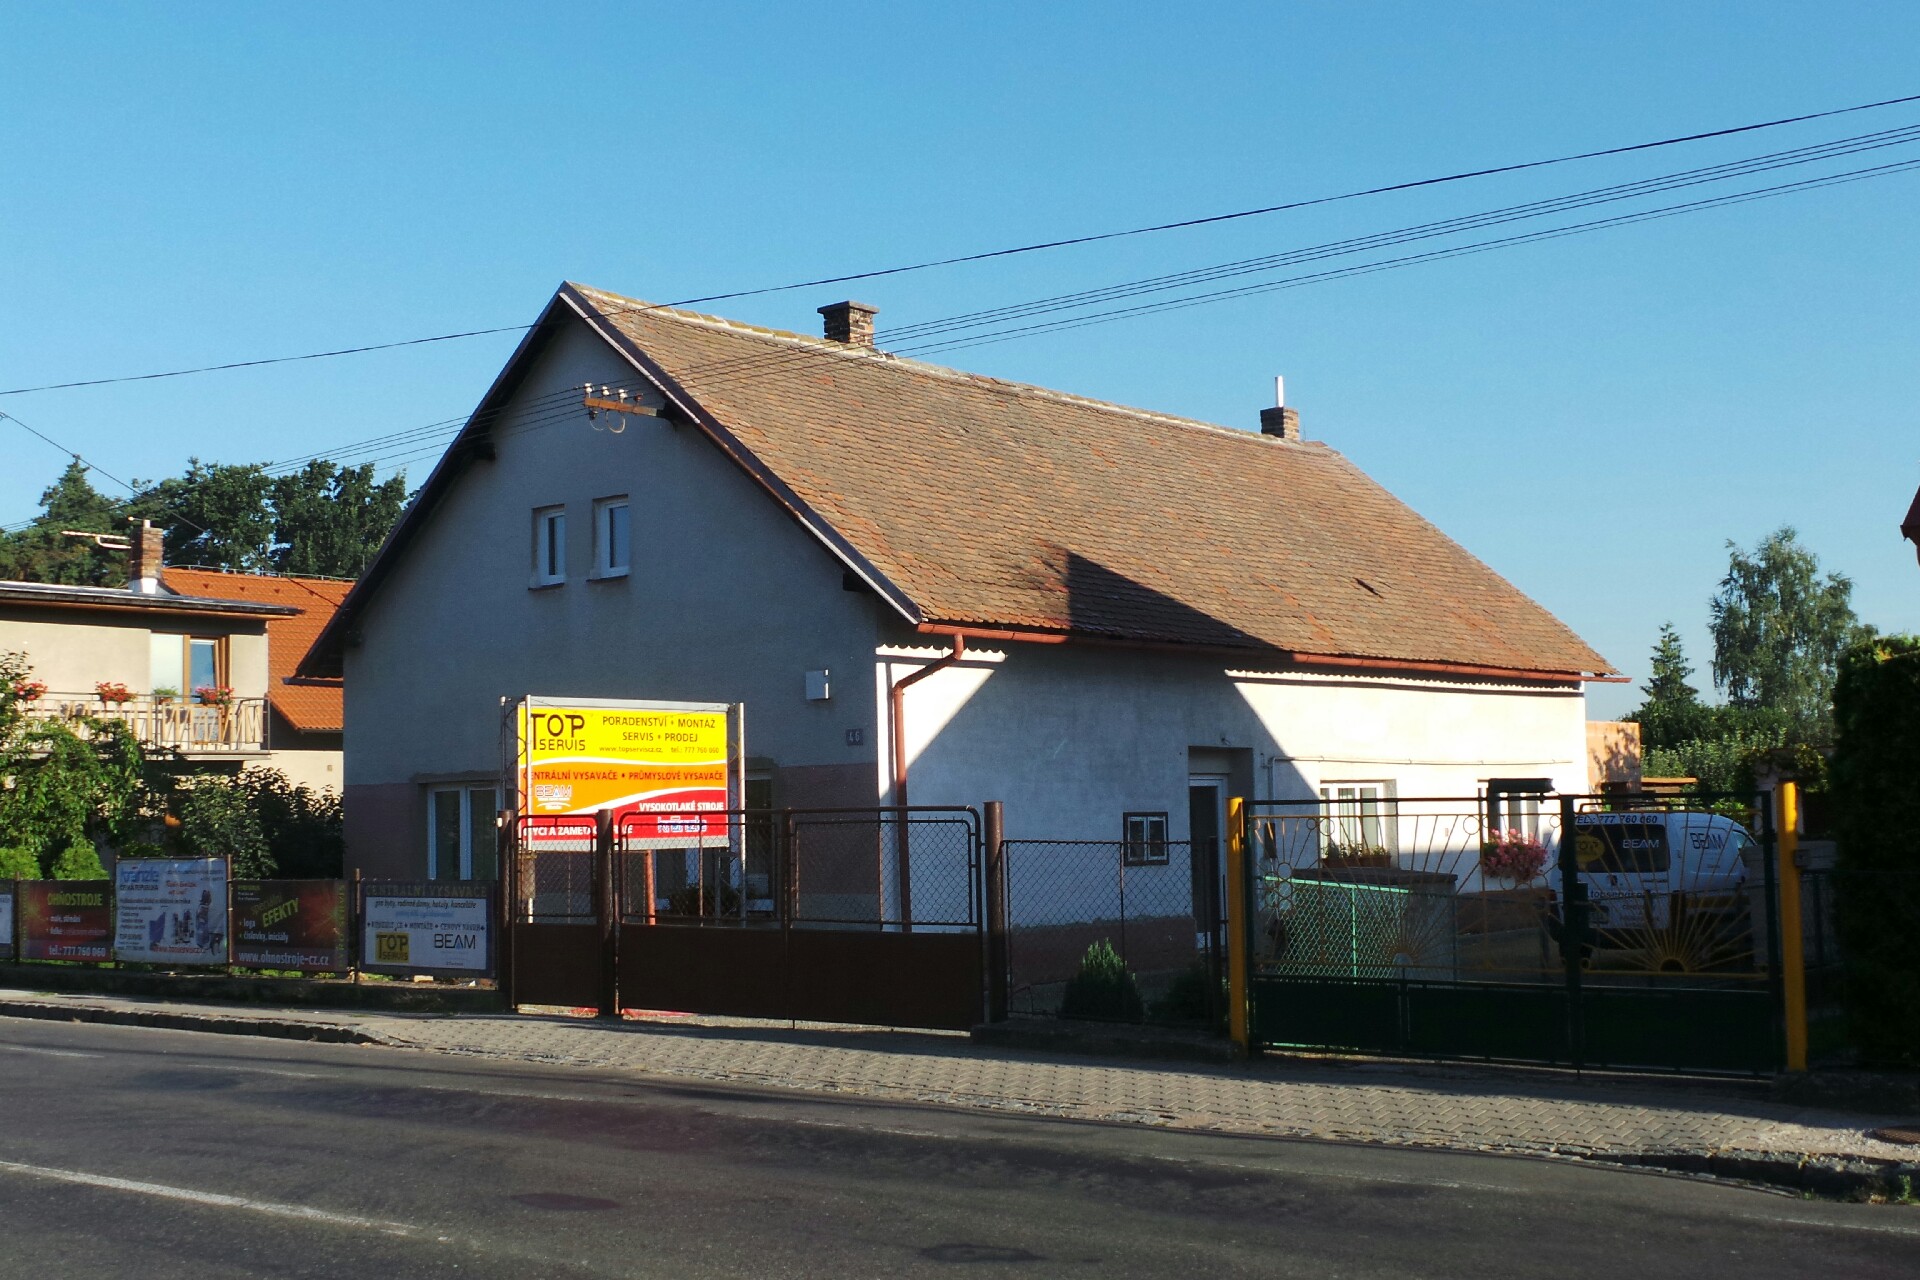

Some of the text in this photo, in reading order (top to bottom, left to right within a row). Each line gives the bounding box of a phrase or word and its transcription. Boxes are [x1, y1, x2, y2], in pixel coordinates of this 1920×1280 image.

[602, 715, 716, 729] PORADENSTVÍ MONTÁŽ
[530, 713, 586, 751] TOP
[622, 731, 698, 743] SERVIS PRODEJ
[539, 739, 586, 751] SERVIS
[572, 769, 618, 781] VYSAVAČE
[628, 769, 681, 781] PRŮMYSLOVÉ
[684, 770, 724, 780] VYSAVAČE
[639, 801, 725, 812] VYSOKOTLAKÉ STROJE
[549, 826, 556, 835] A
[1622, 839, 1659, 849] BEAM
[48, 891, 104, 906] OHŇOSTROJE
[262, 897, 300, 928] EFEKTY
[376, 934, 409, 959] TOP
[434, 933, 476, 949] BEAM
